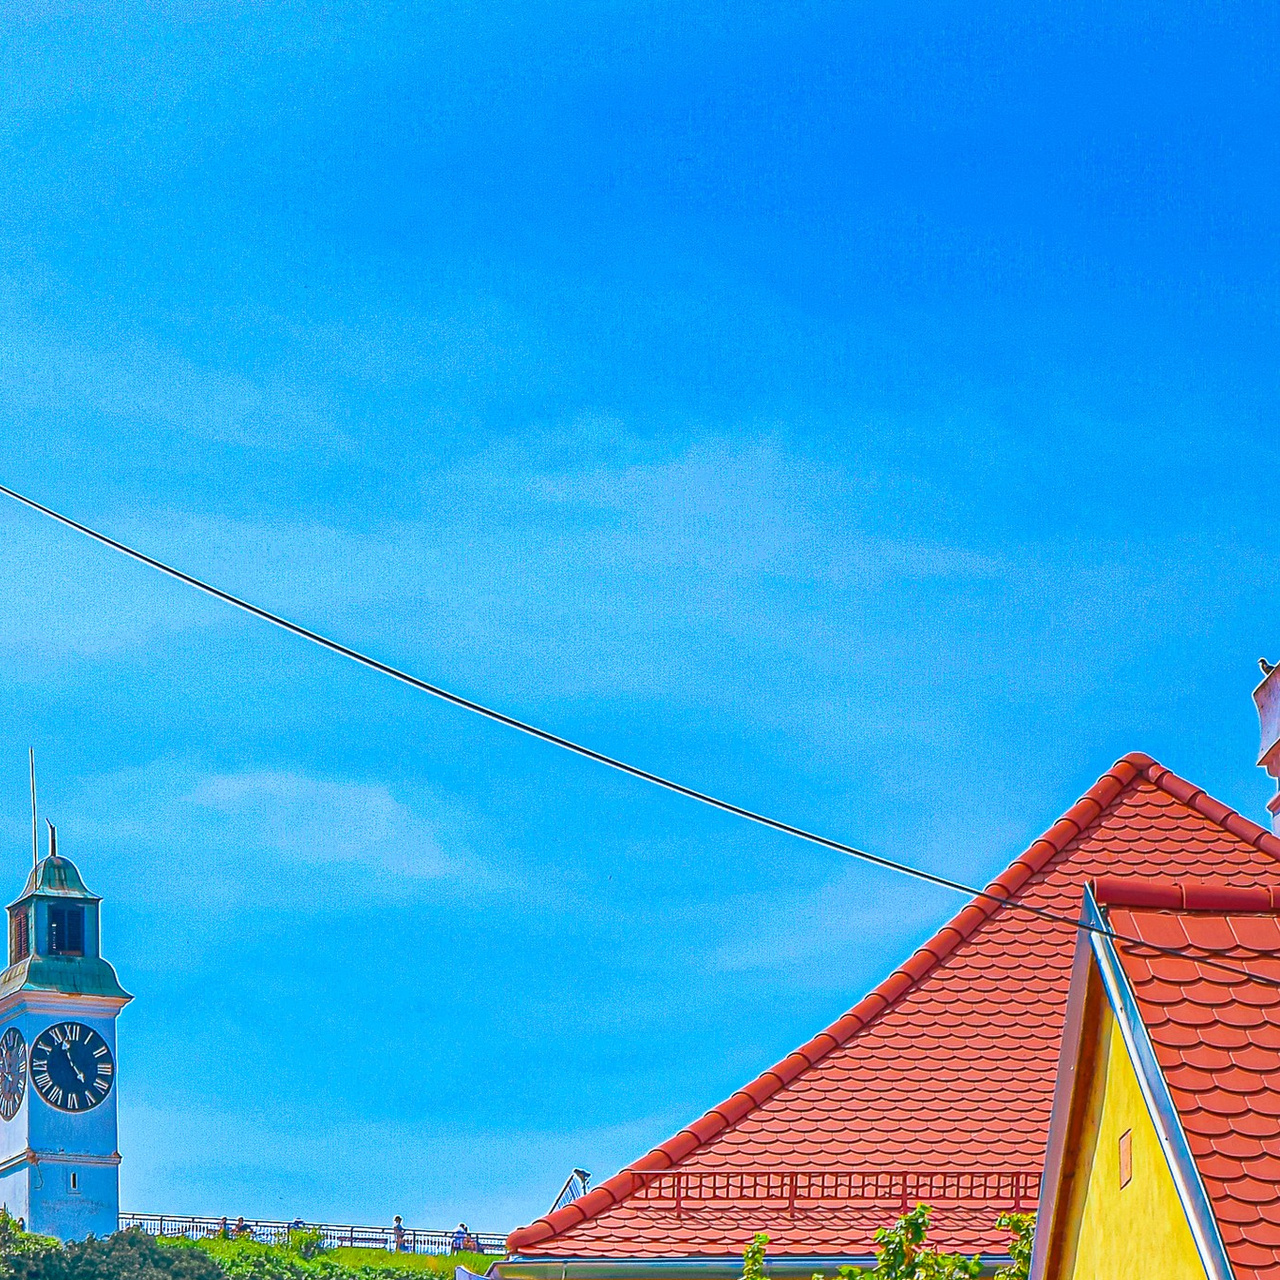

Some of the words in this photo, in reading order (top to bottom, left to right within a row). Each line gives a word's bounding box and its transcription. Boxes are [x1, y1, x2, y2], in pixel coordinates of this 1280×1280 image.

[49, 1027, 63, 1046] XI
[64, 1025, 80, 1041] XII
[84, 1031, 94, 1045] I
[37, 1041, 52, 1055] X
[92, 1045, 108, 1058] II
[33, 1058, 48, 1071] IX
[97, 1063, 112, 1075] III
[35, 1072, 53, 1093] VIII
[93, 1078, 109, 1095] IV
[47, 1085, 63, 1106] VII
[67, 1093, 79, 1109] VI
[84, 1090, 96, 1107] V
